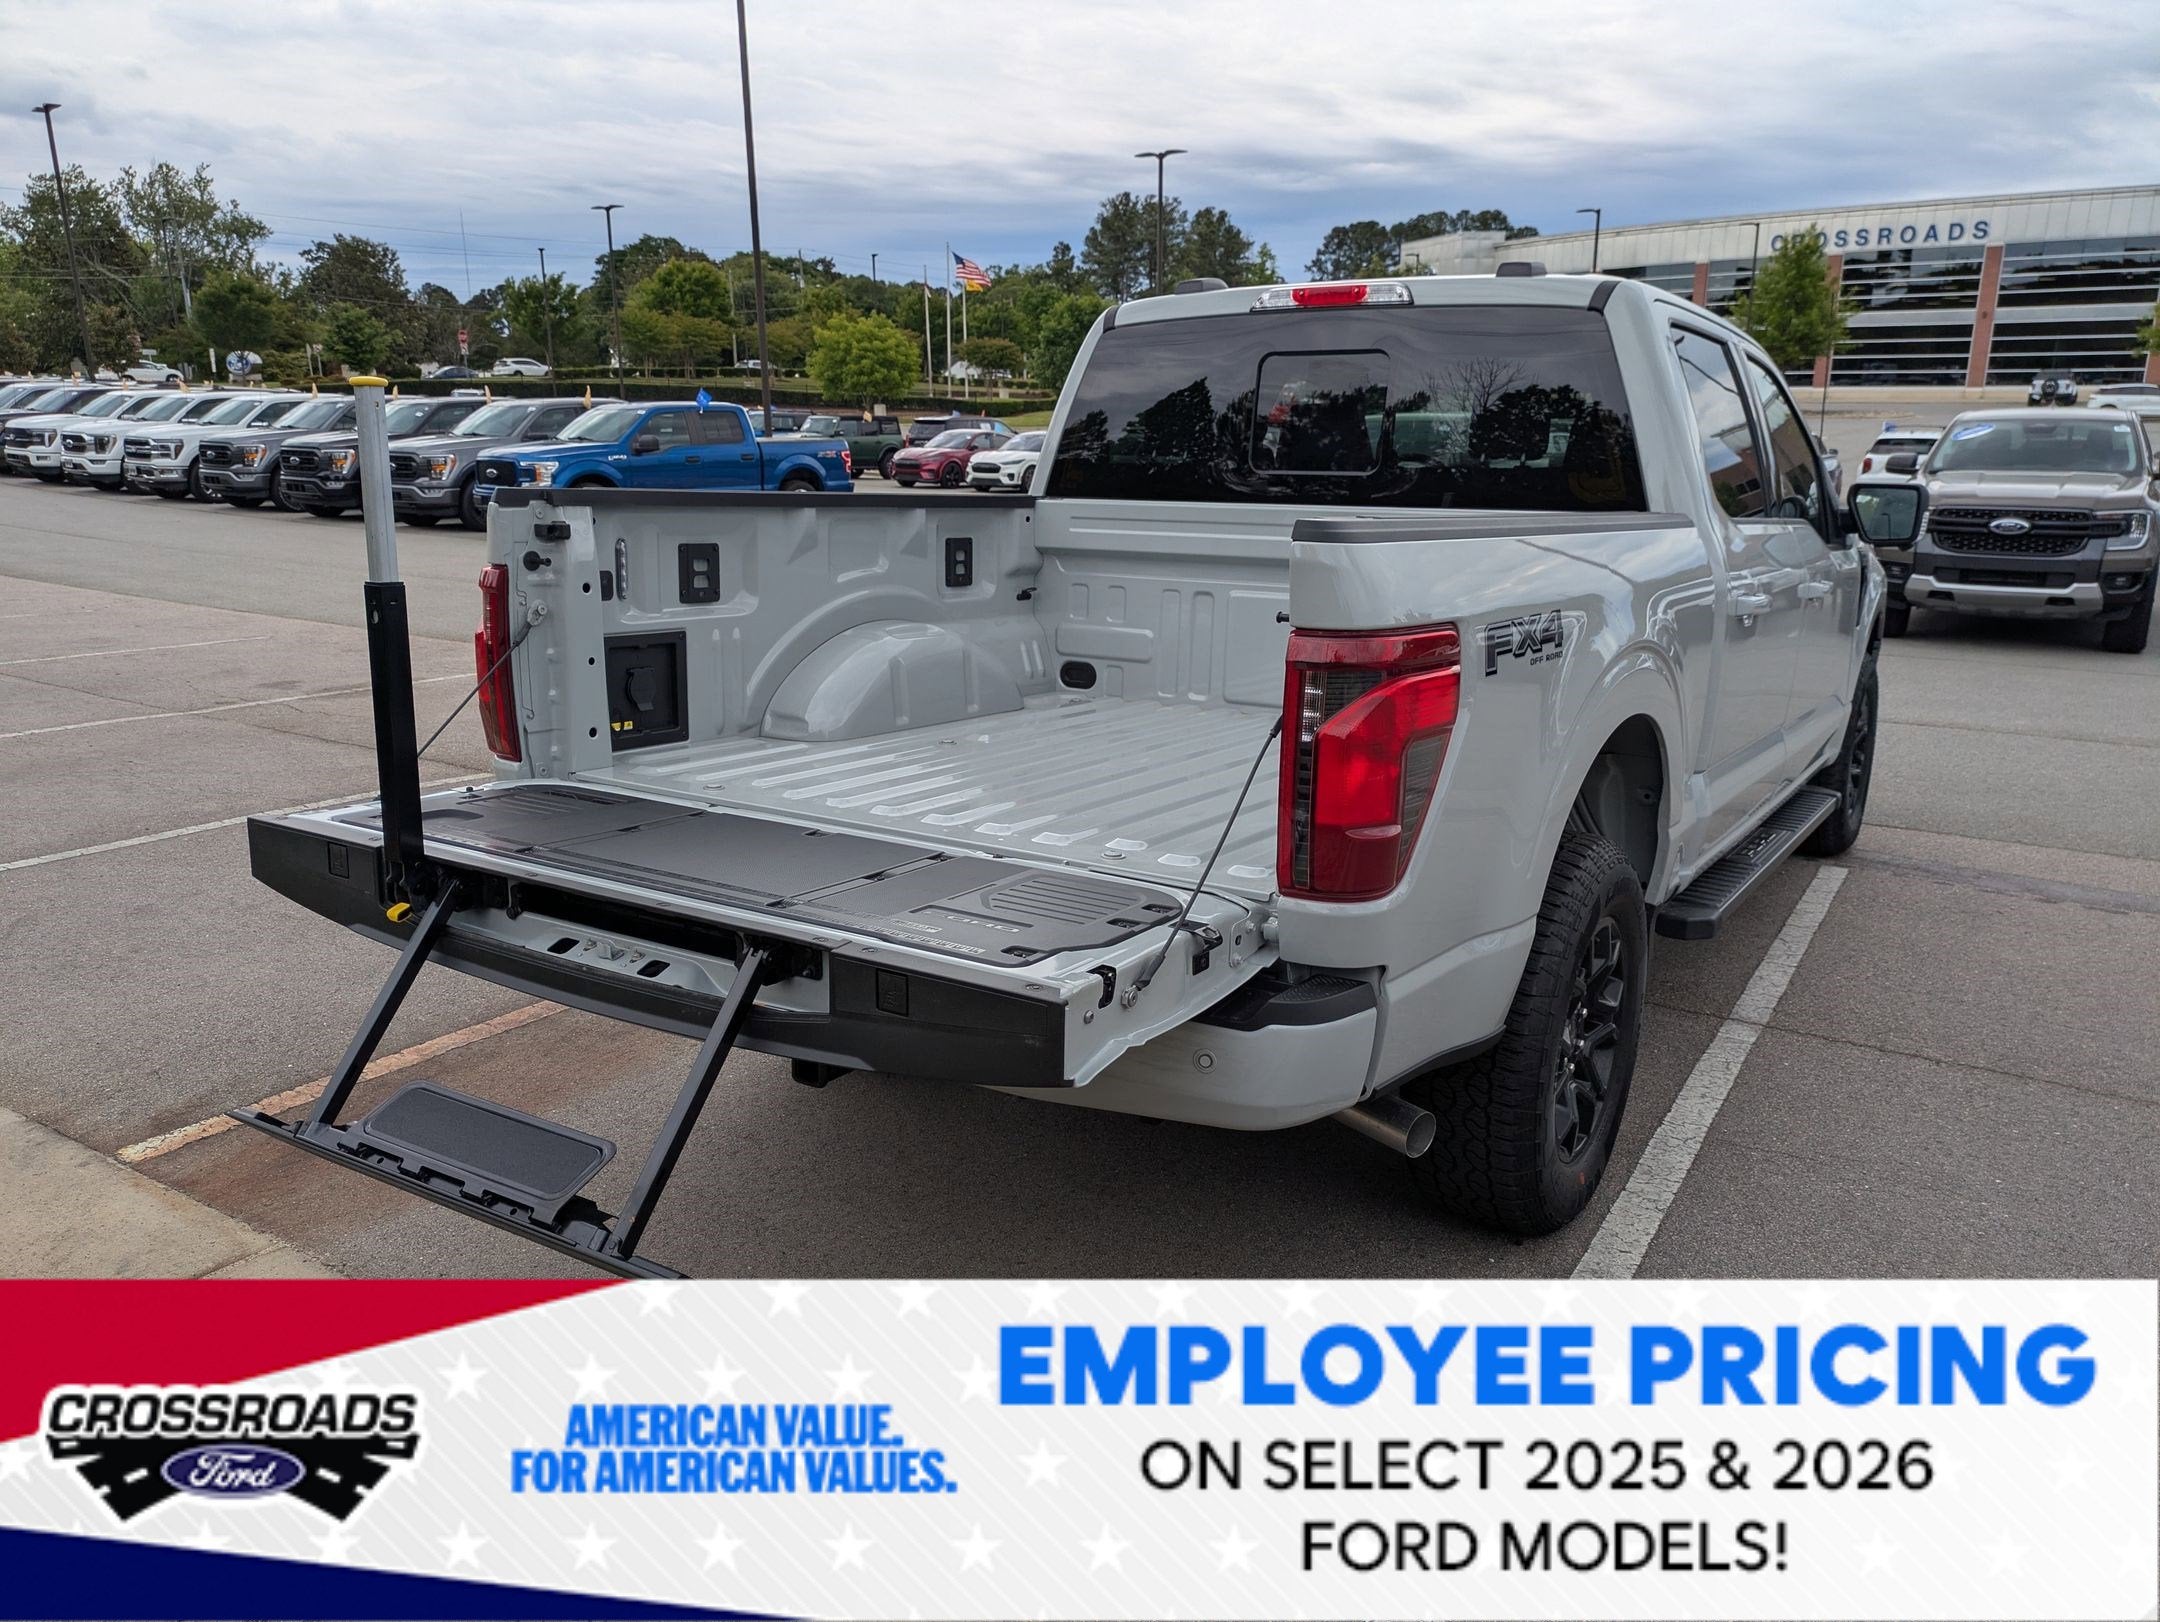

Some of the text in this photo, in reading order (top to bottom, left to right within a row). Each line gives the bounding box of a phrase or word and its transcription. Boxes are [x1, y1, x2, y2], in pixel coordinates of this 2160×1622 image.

[1484, 609, 1563, 676] FX4
[1530, 650, 1563, 665] OFF ROAD
